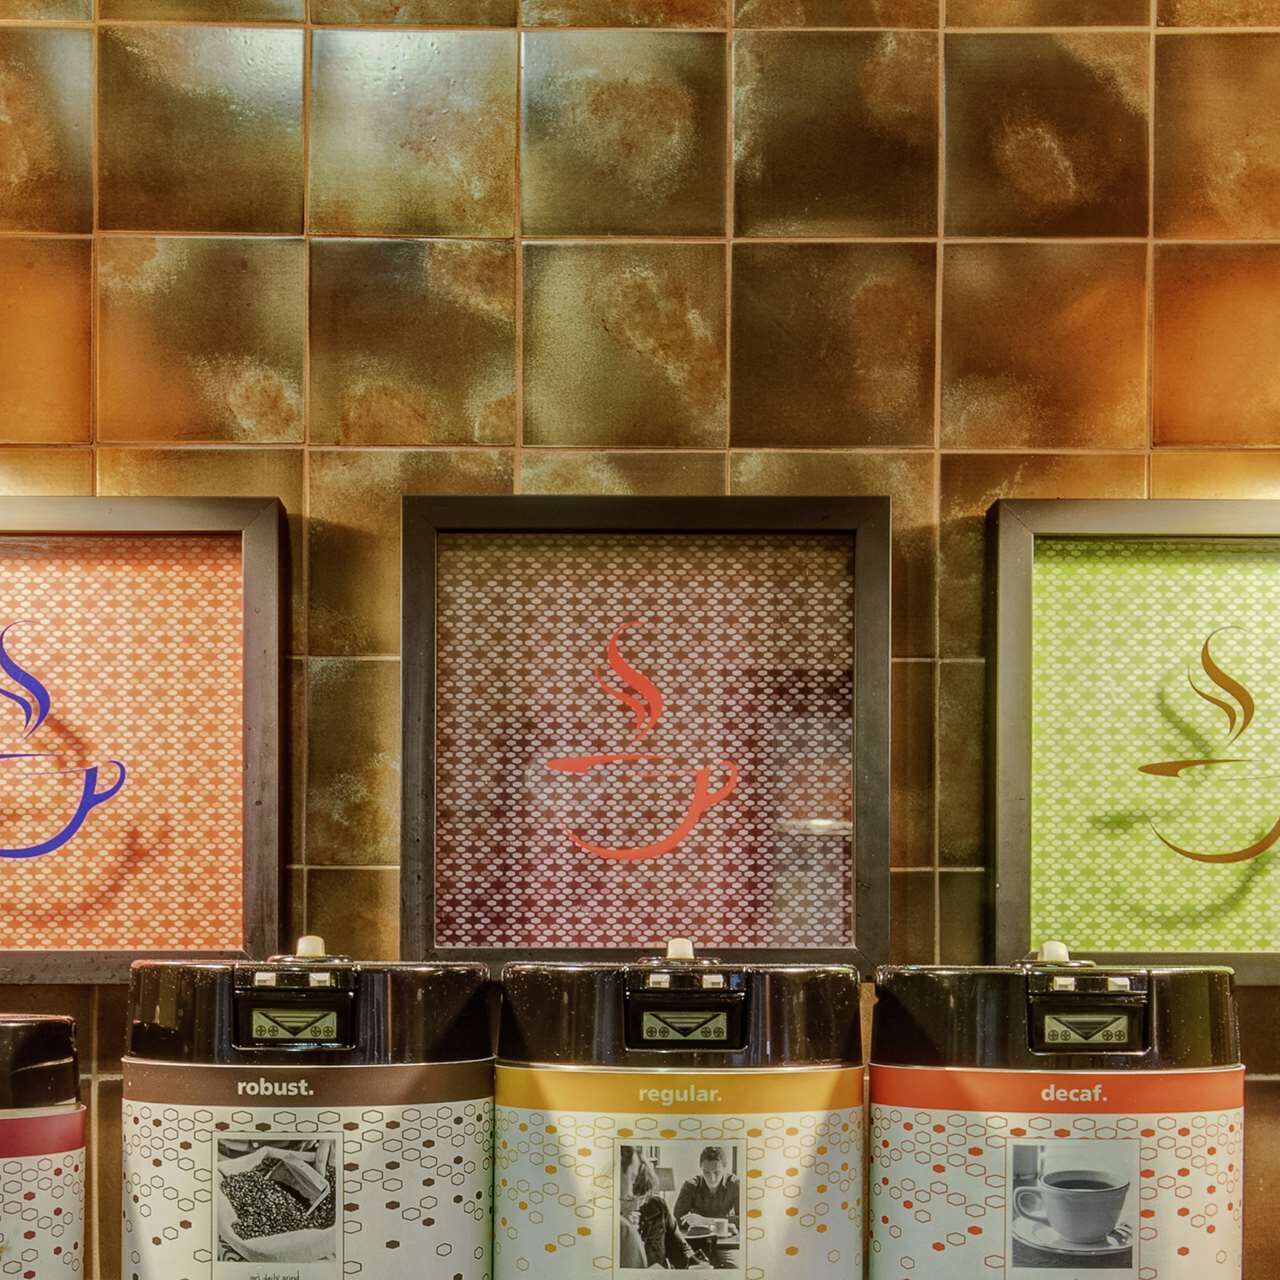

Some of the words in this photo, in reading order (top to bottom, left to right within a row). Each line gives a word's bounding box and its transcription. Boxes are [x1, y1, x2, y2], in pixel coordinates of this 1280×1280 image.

[237, 1077, 314, 1096] robust.
[639, 1084, 722, 1106] regular.
[1041, 1084, 1108, 1102] decaf.
